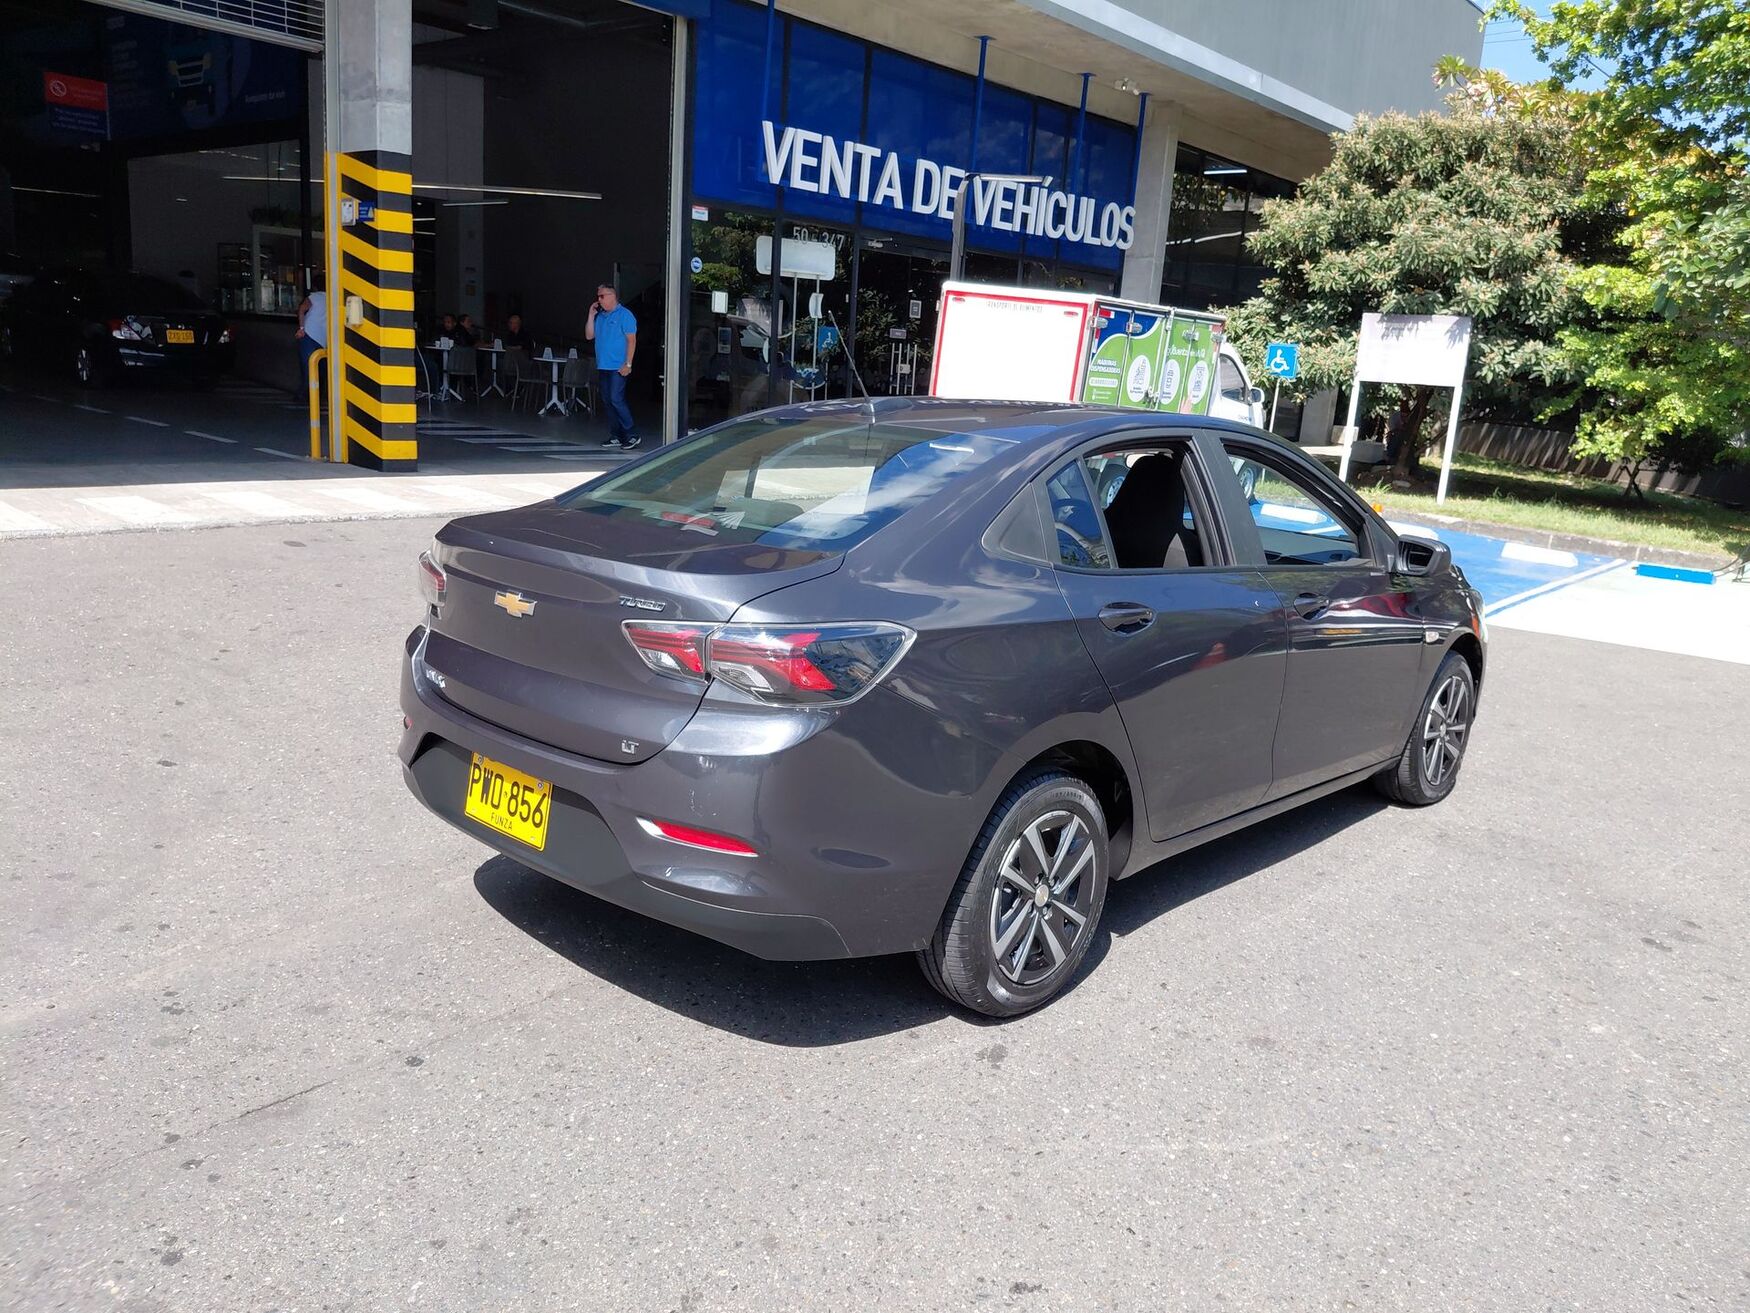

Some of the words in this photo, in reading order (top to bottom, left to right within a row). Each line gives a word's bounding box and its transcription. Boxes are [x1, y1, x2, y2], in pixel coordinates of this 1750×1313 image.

[762, 120, 903, 210] VENTA
[912, 158, 966, 220] DE
[973, 175, 1136, 250] VEHÍCULOS
[793, 226, 808, 245] 50
[618, 595, 666, 612] TURBO
[621, 739, 639, 754] LT
[507, 781, 547, 828] 856
[490, 812, 513, 831] FUNZA
